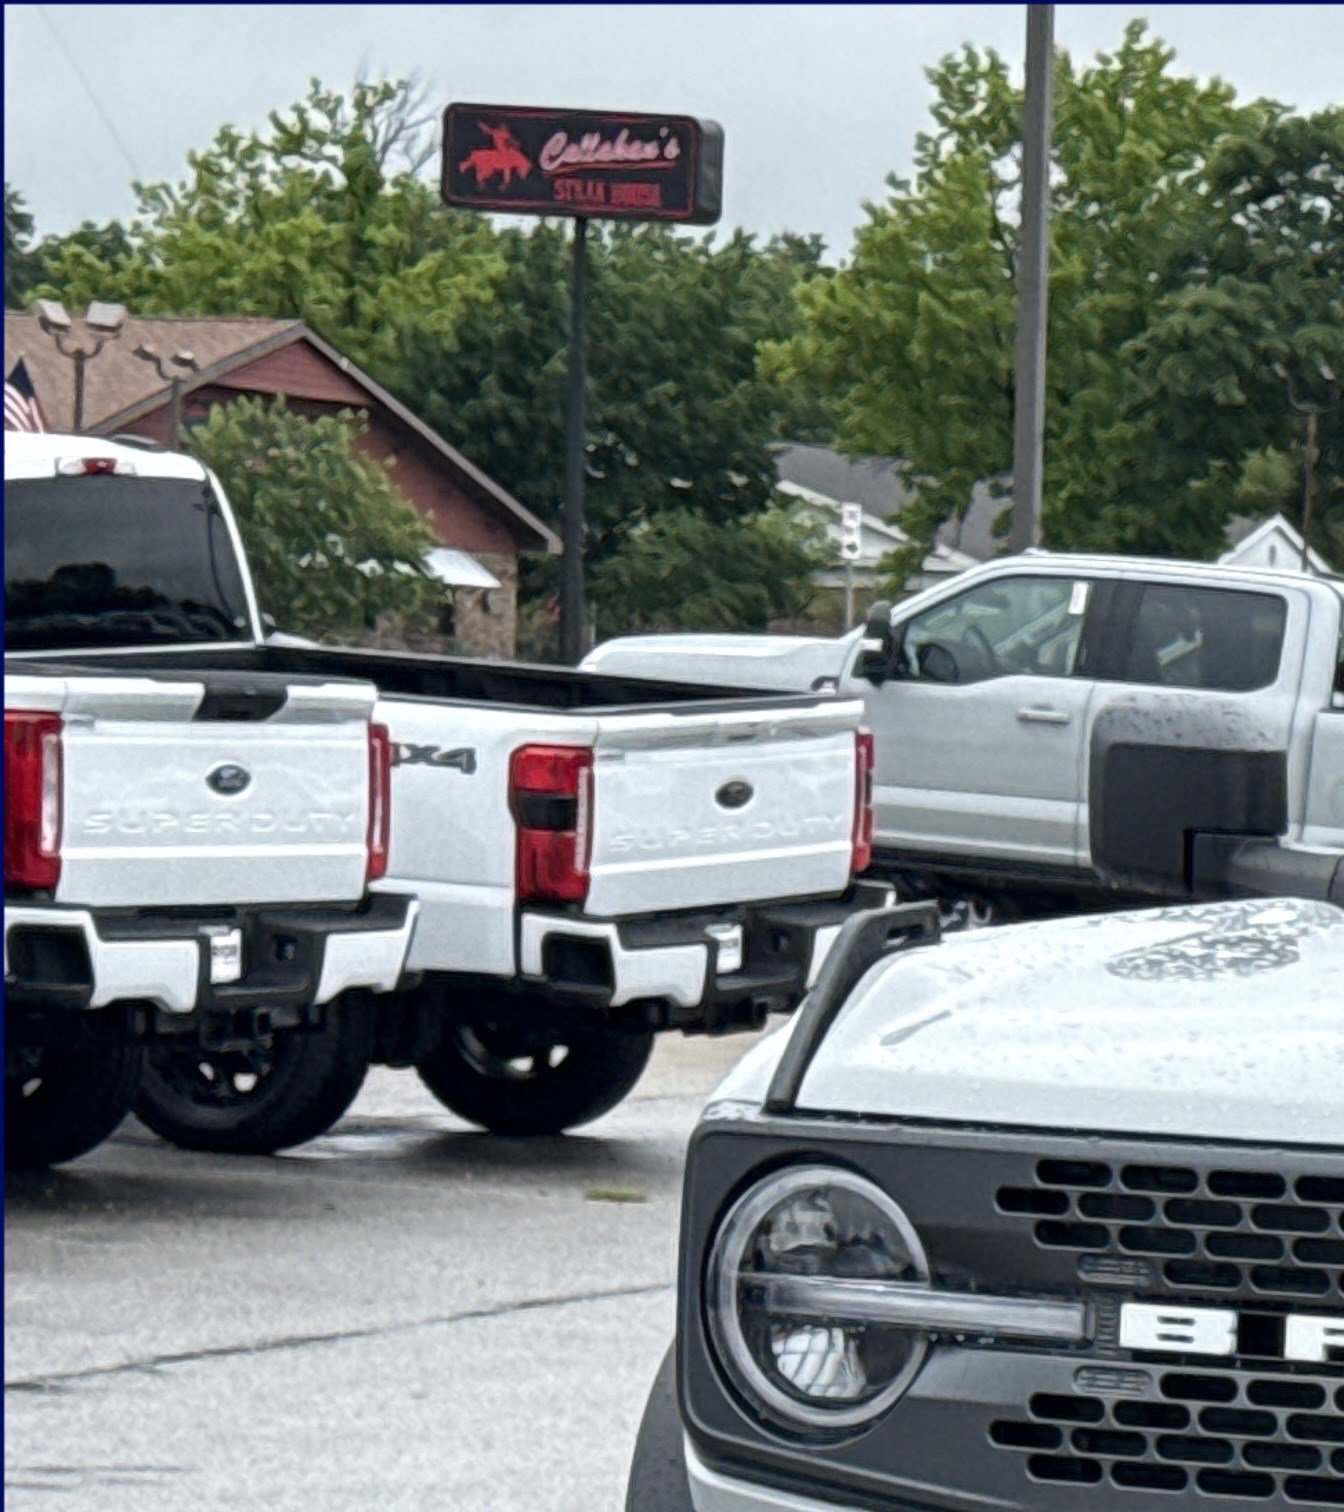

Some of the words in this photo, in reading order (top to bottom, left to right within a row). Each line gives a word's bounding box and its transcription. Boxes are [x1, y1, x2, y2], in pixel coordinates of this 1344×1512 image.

[83, 811, 241, 834] SUPER
[249, 811, 355, 834] DUTY
[608, 826, 739, 852] SUPER
[753, 814, 844, 840] DUTY
